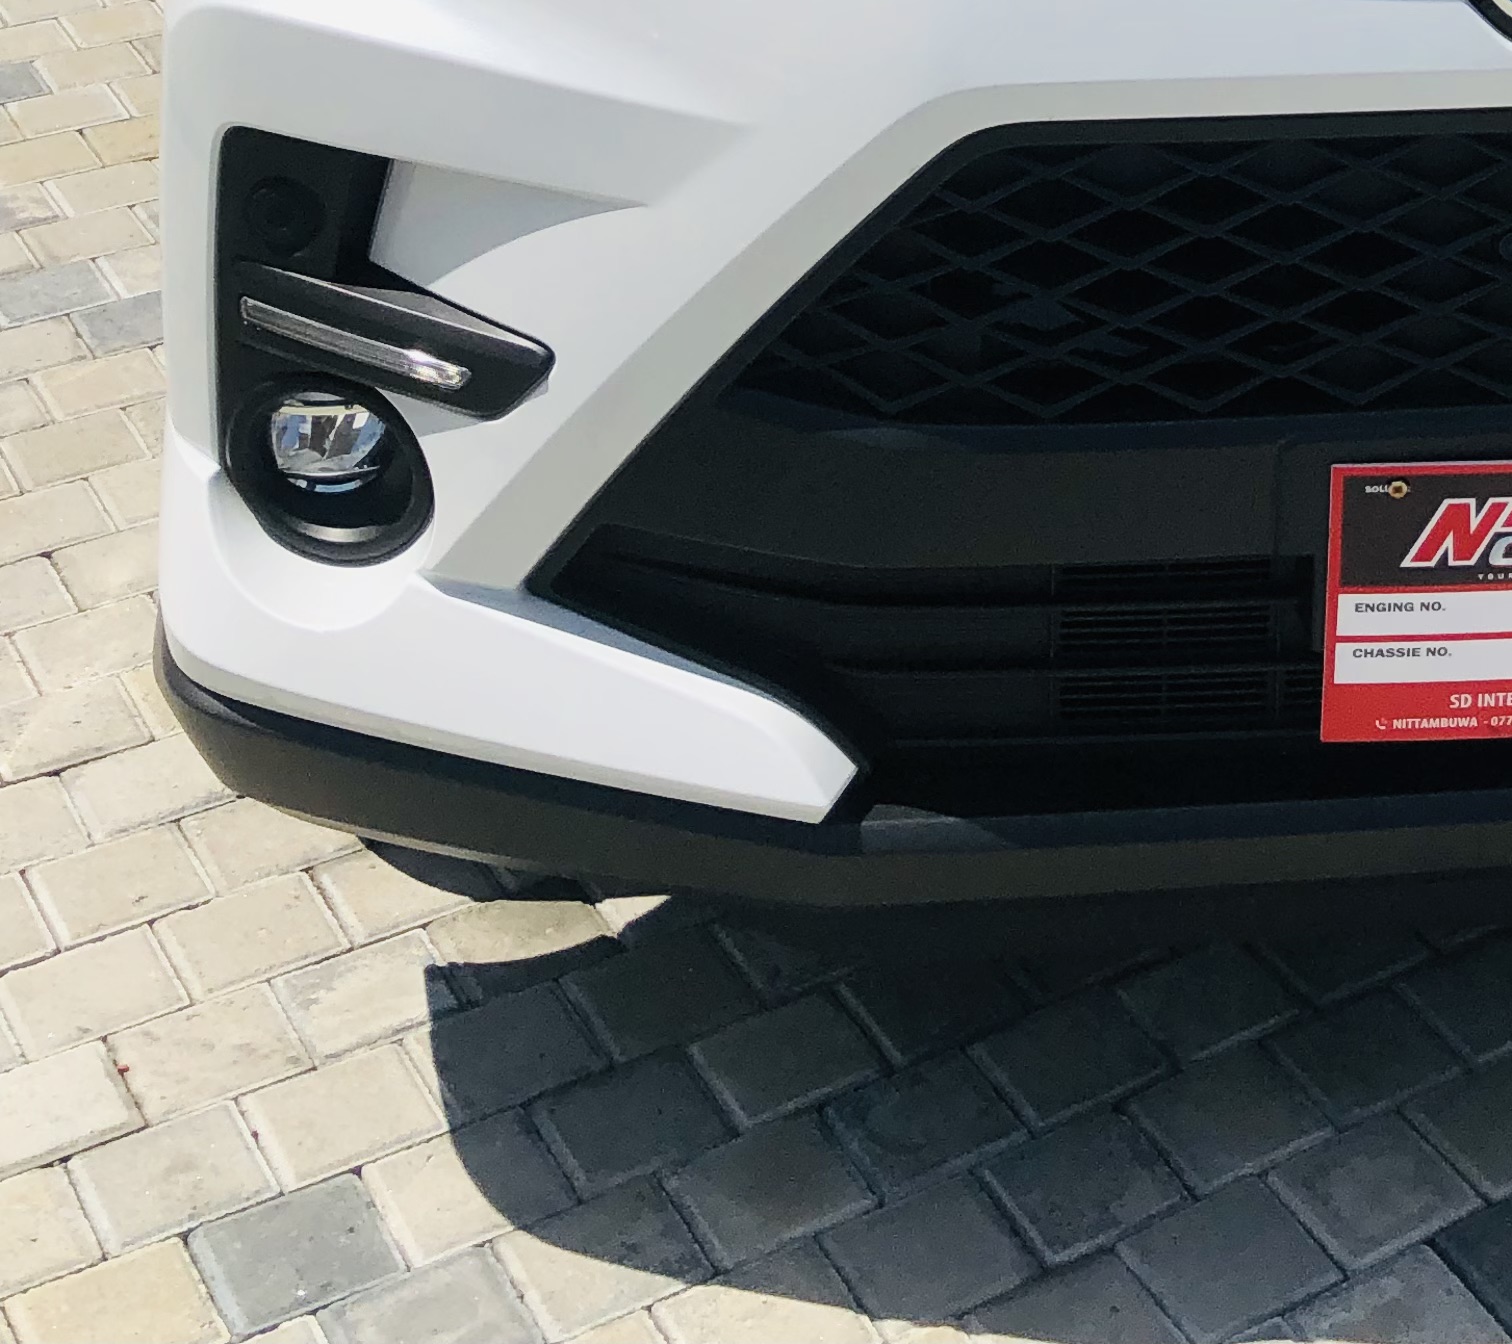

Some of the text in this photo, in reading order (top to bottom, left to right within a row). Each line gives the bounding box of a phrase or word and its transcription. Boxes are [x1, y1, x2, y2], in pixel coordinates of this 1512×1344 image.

[1354, 601, 1446, 613] ENGING NO.
[1352, 646, 1452, 659] CHASSIE NO.
[1449, 693, 1473, 709] SD
[1392, 716, 1478, 730] NITTAMBUWA
